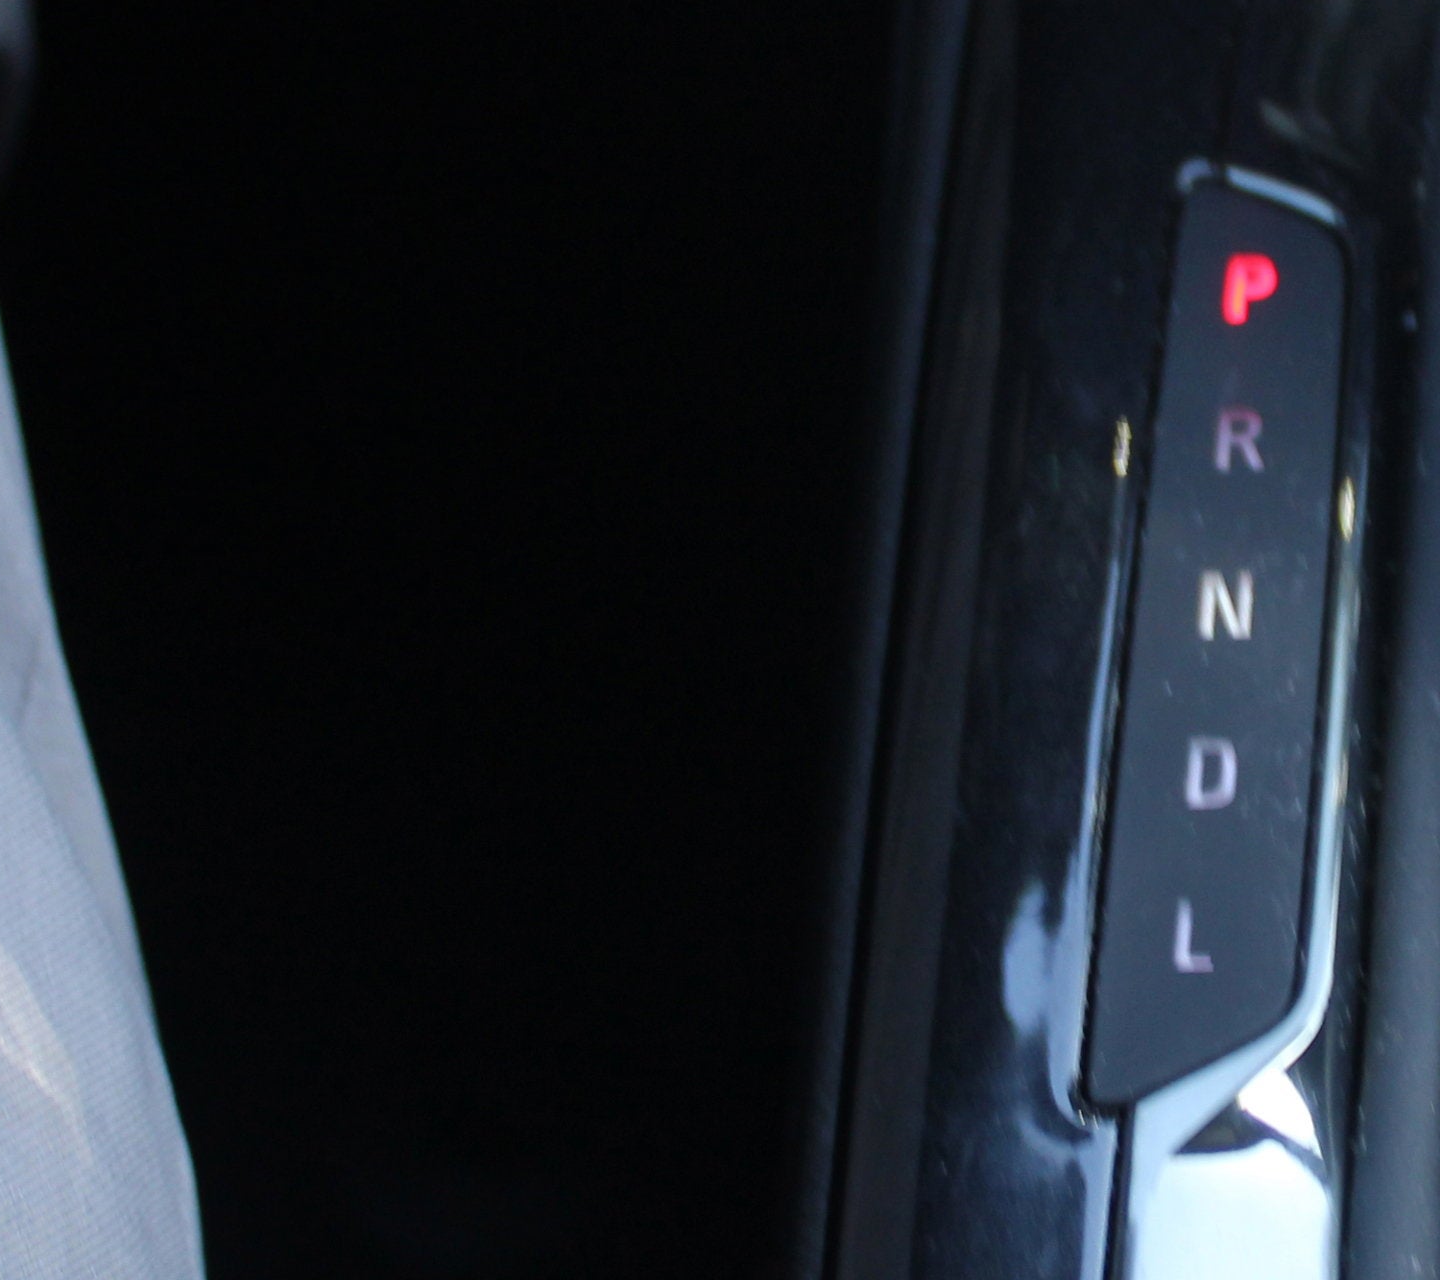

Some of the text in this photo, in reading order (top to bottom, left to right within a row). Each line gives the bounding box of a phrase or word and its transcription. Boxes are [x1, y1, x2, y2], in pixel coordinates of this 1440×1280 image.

[1220, 253, 1280, 326] P
[1212, 407, 1266, 474] R
[1197, 568, 1254, 642] N
[1184, 735, 1239, 811] D
[1172, 898, 1215, 974] L
